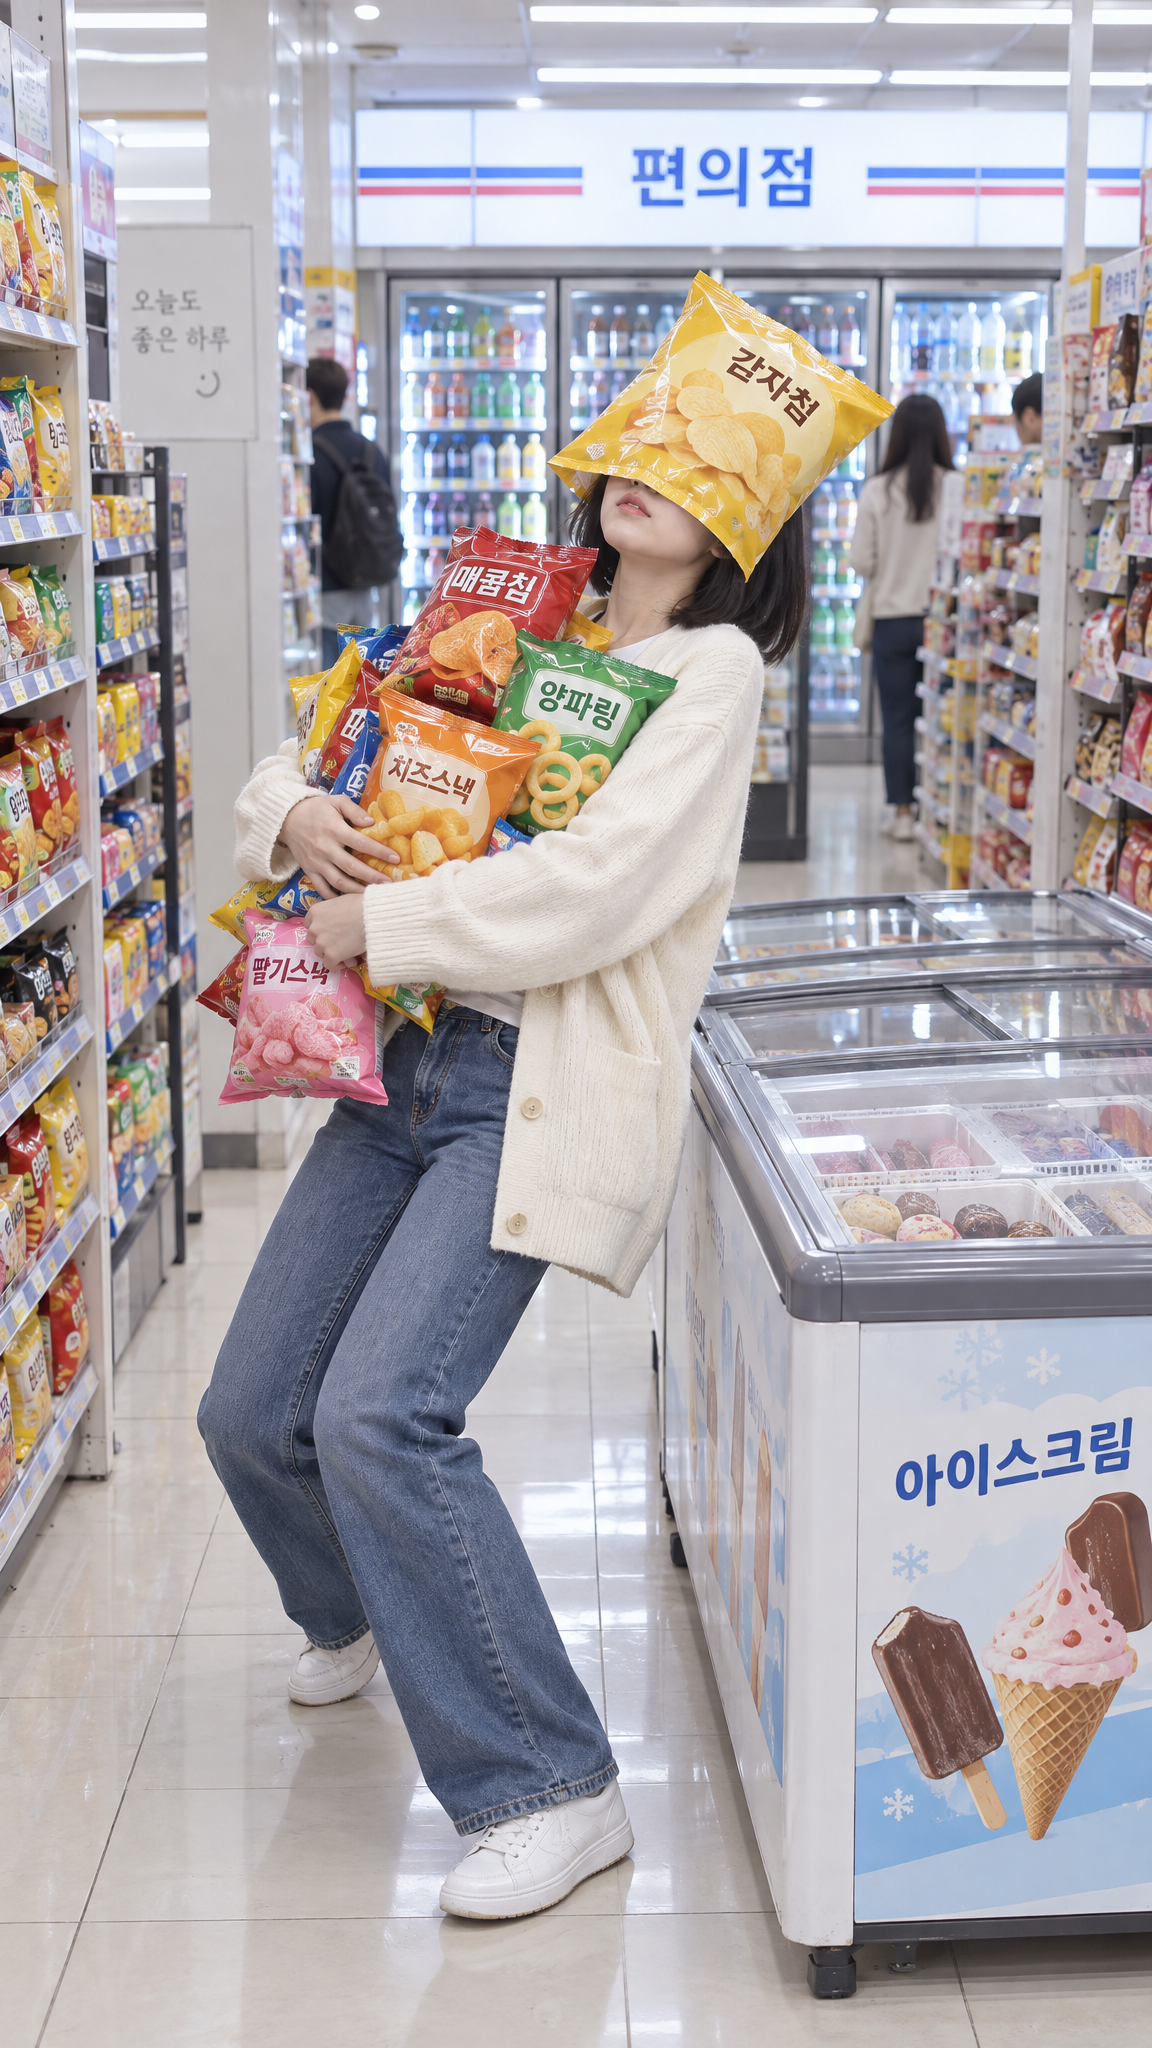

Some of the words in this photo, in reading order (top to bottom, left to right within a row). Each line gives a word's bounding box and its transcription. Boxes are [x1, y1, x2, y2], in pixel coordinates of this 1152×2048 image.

[632, 146, 813, 207] 편의점
[131, 288, 202, 315] 오늘도
[131, 325, 178, 354] 좋은
[186, 325, 230, 353] 하루
[538, 680, 621, 731] 양파링
[388, 754, 476, 805] 치즈스낵
[895, 1416, 1133, 1507] 아이스크림
